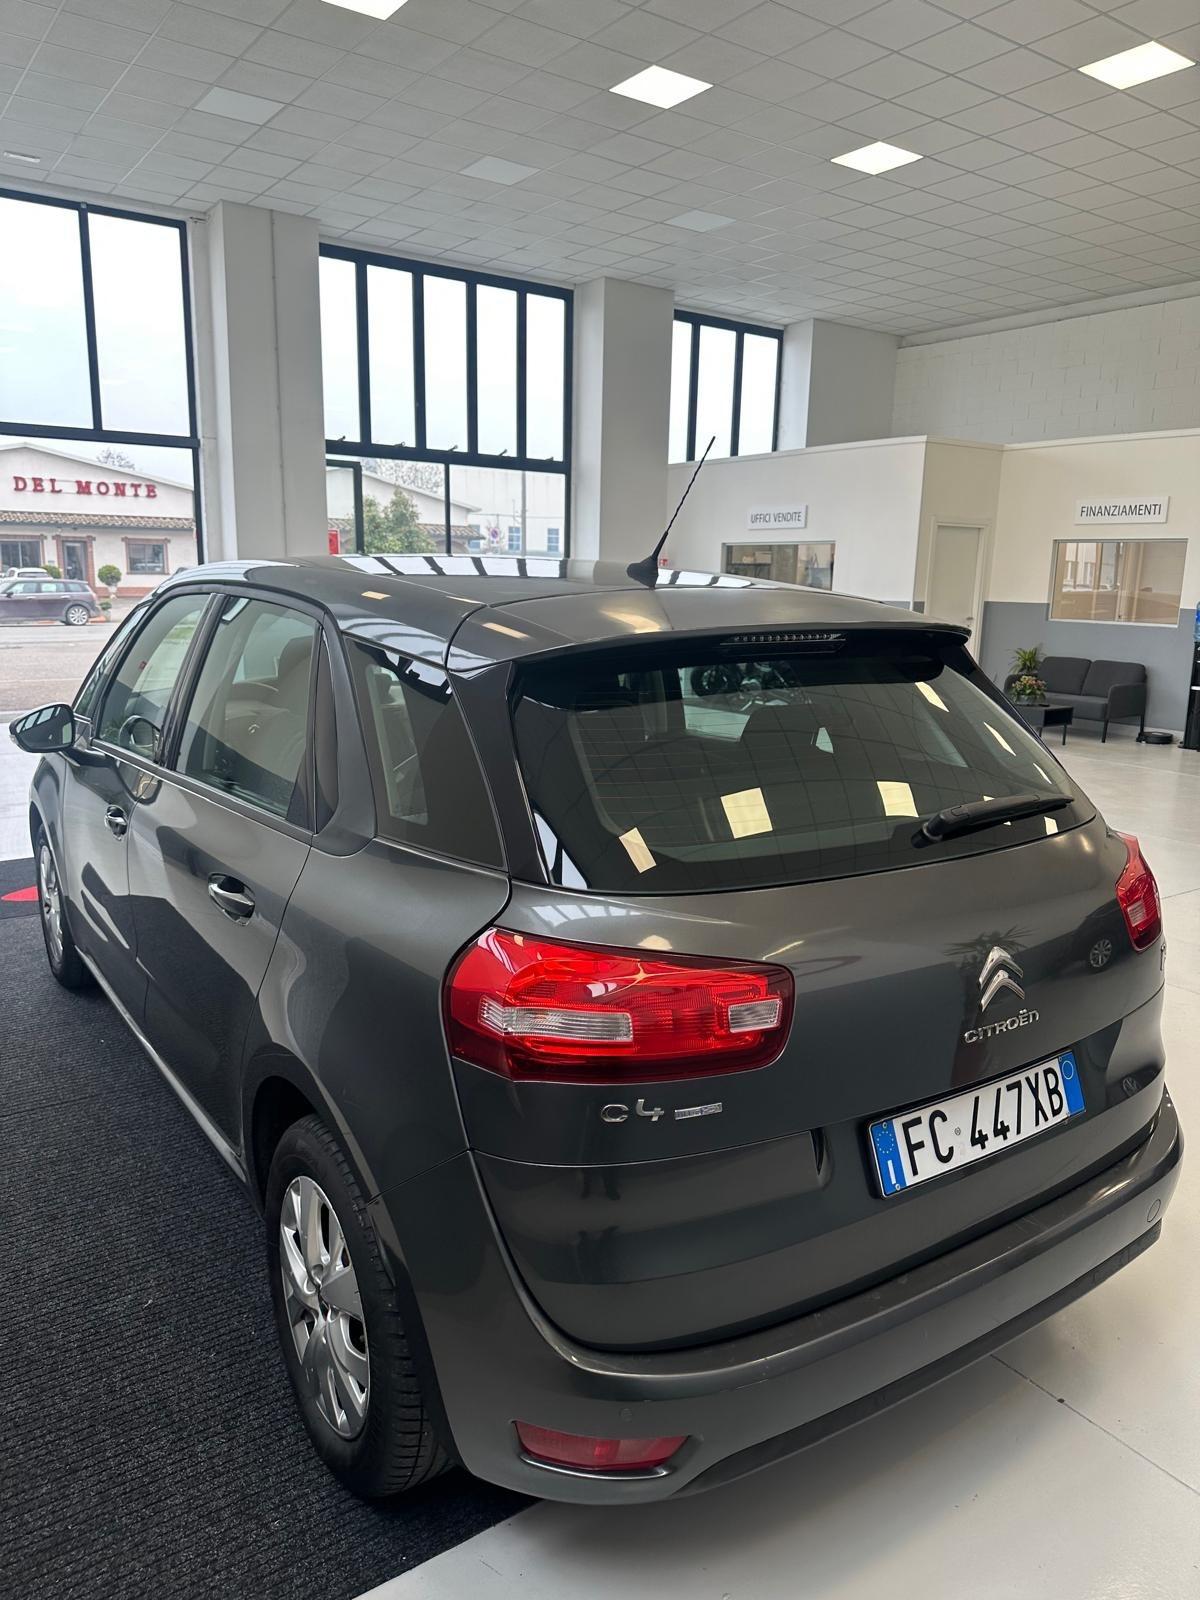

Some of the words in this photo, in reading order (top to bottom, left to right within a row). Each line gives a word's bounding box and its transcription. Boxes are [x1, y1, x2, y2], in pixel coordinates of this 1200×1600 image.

[13, 476, 62, 494] DEL
[75, 480, 158, 498] MONTE
[750, 513, 771, 524] UFFICI
[773, 511, 802, 523] VENDITE
[1080, 503, 1161, 517] FINANZIAMENTI
[600, 1098, 665, 1122] C4
[901, 1110, 954, 1176] FC
[970, 1067, 1064, 1150] 447XB
